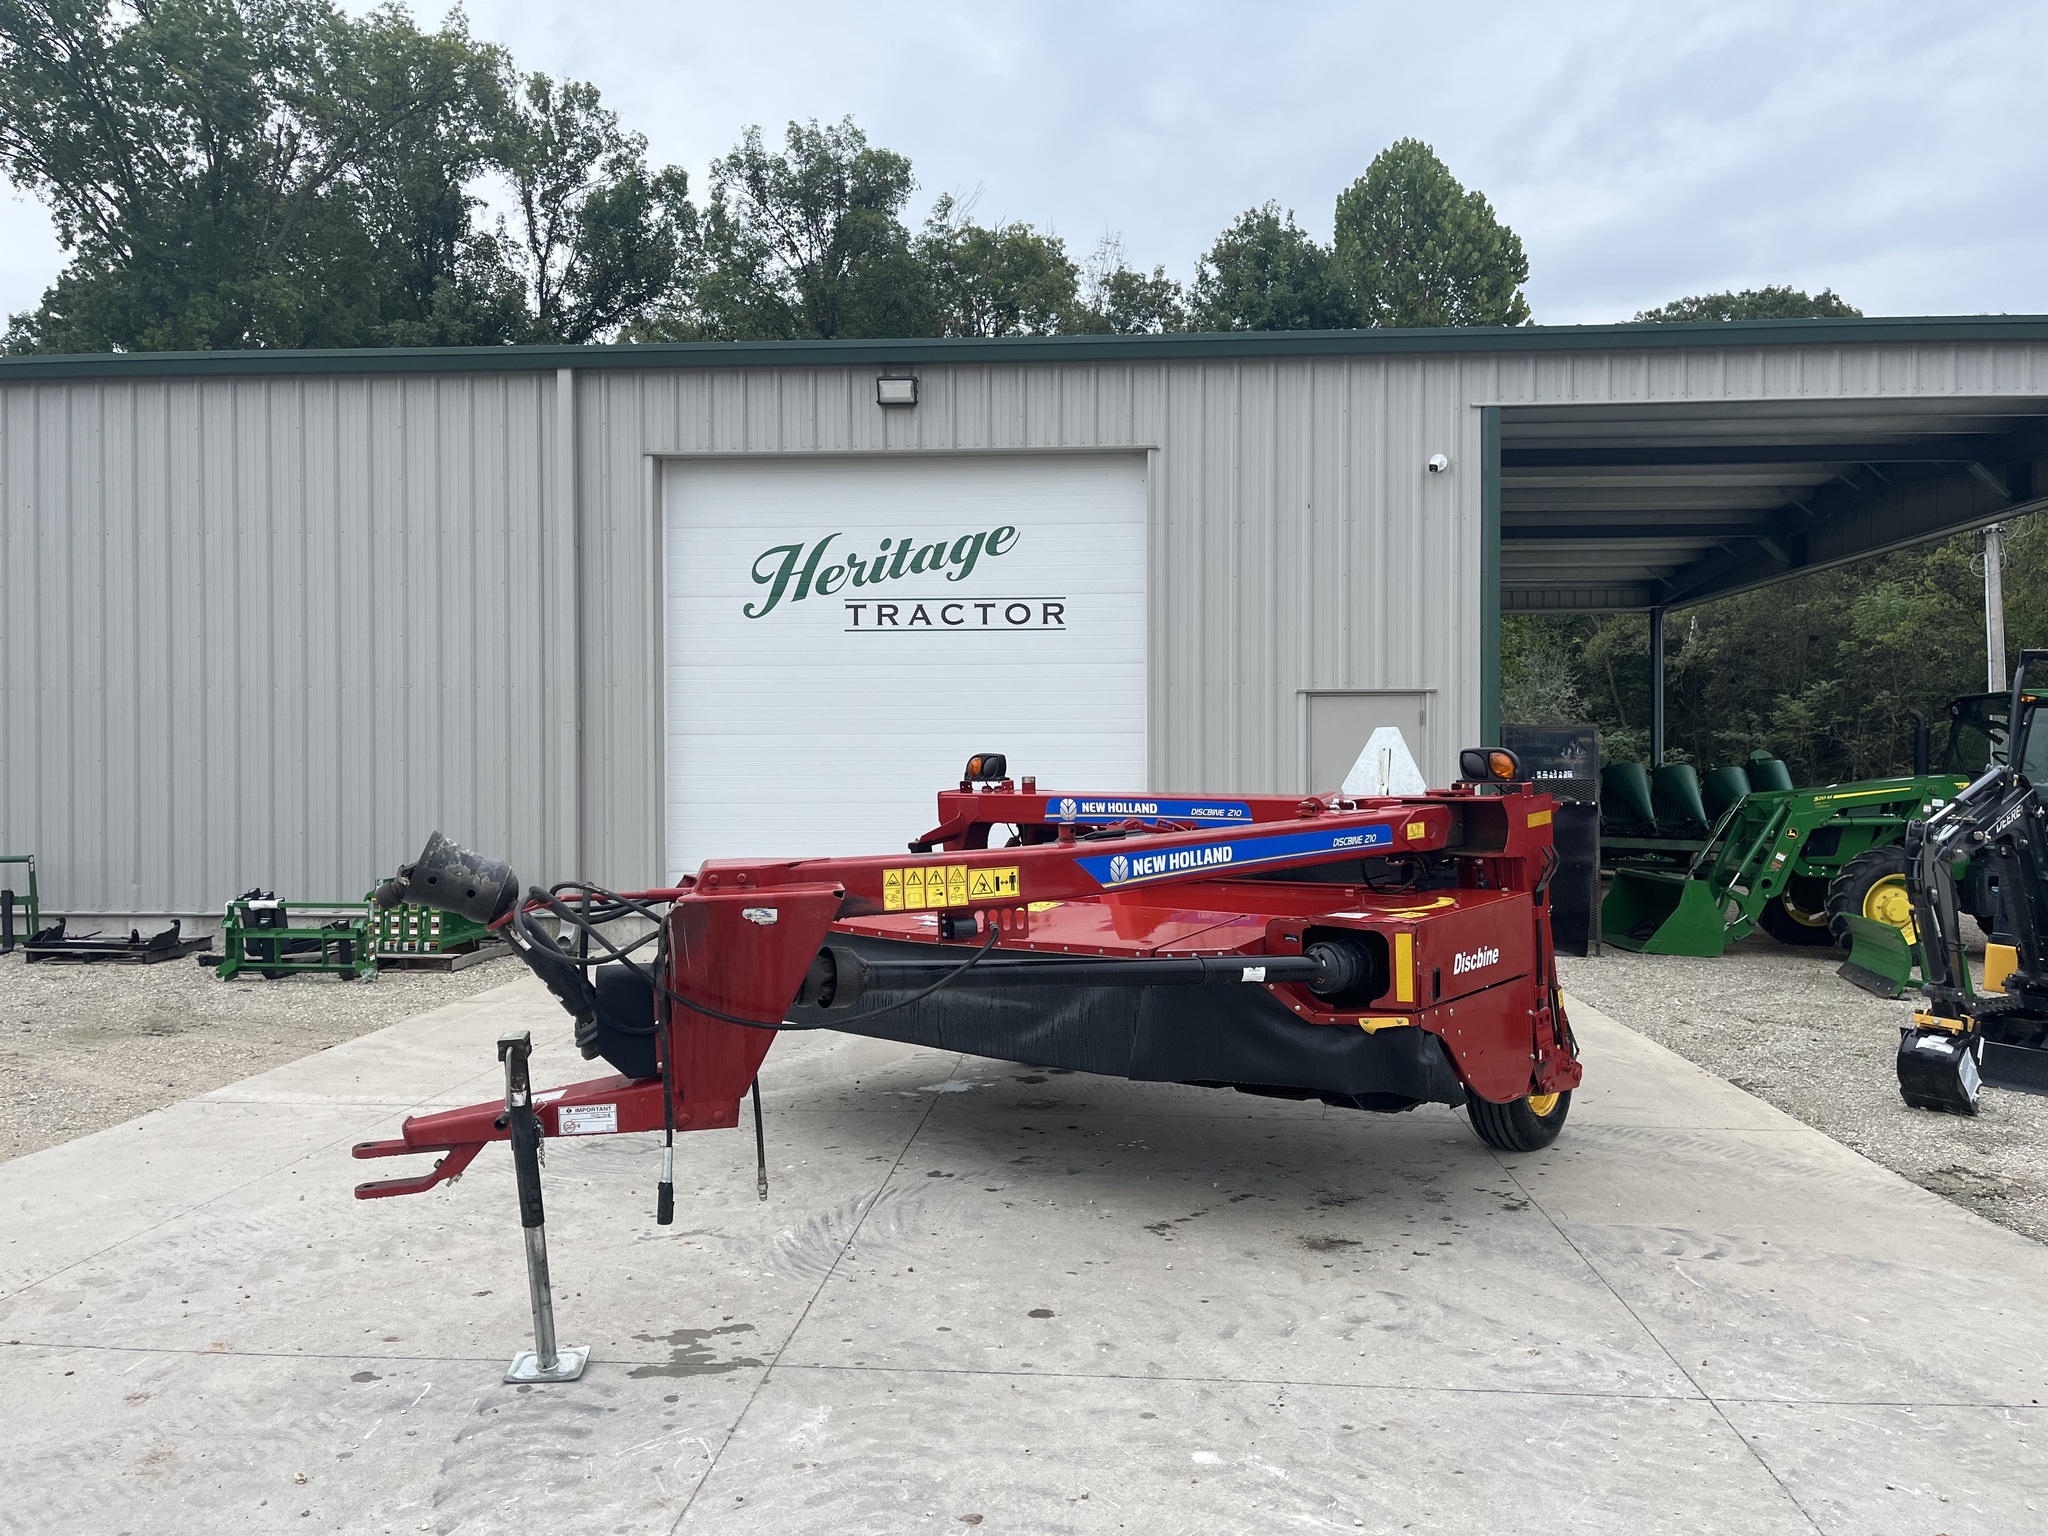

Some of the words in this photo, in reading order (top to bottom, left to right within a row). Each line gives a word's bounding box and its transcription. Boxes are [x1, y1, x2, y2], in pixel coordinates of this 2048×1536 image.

[743, 525, 1021, 619] Heritage
[845, 602, 1066, 627] TRACTOR
[1081, 802, 1107, 813] NEW
[1107, 803, 1158, 814] HOLLAND
[1190, 808, 1225, 817] DISCBINE
[1227, 809, 1242, 817] 210
[1996, 804, 2021, 834] DEERE
[1332, 834, 1362, 847] DISCBINE
[1364, 833, 1377, 844] 210
[1132, 854, 1167, 876] NEW
[1169, 846, 1233, 869] HOLLAND
[1453, 945, 1499, 975] Discbine
